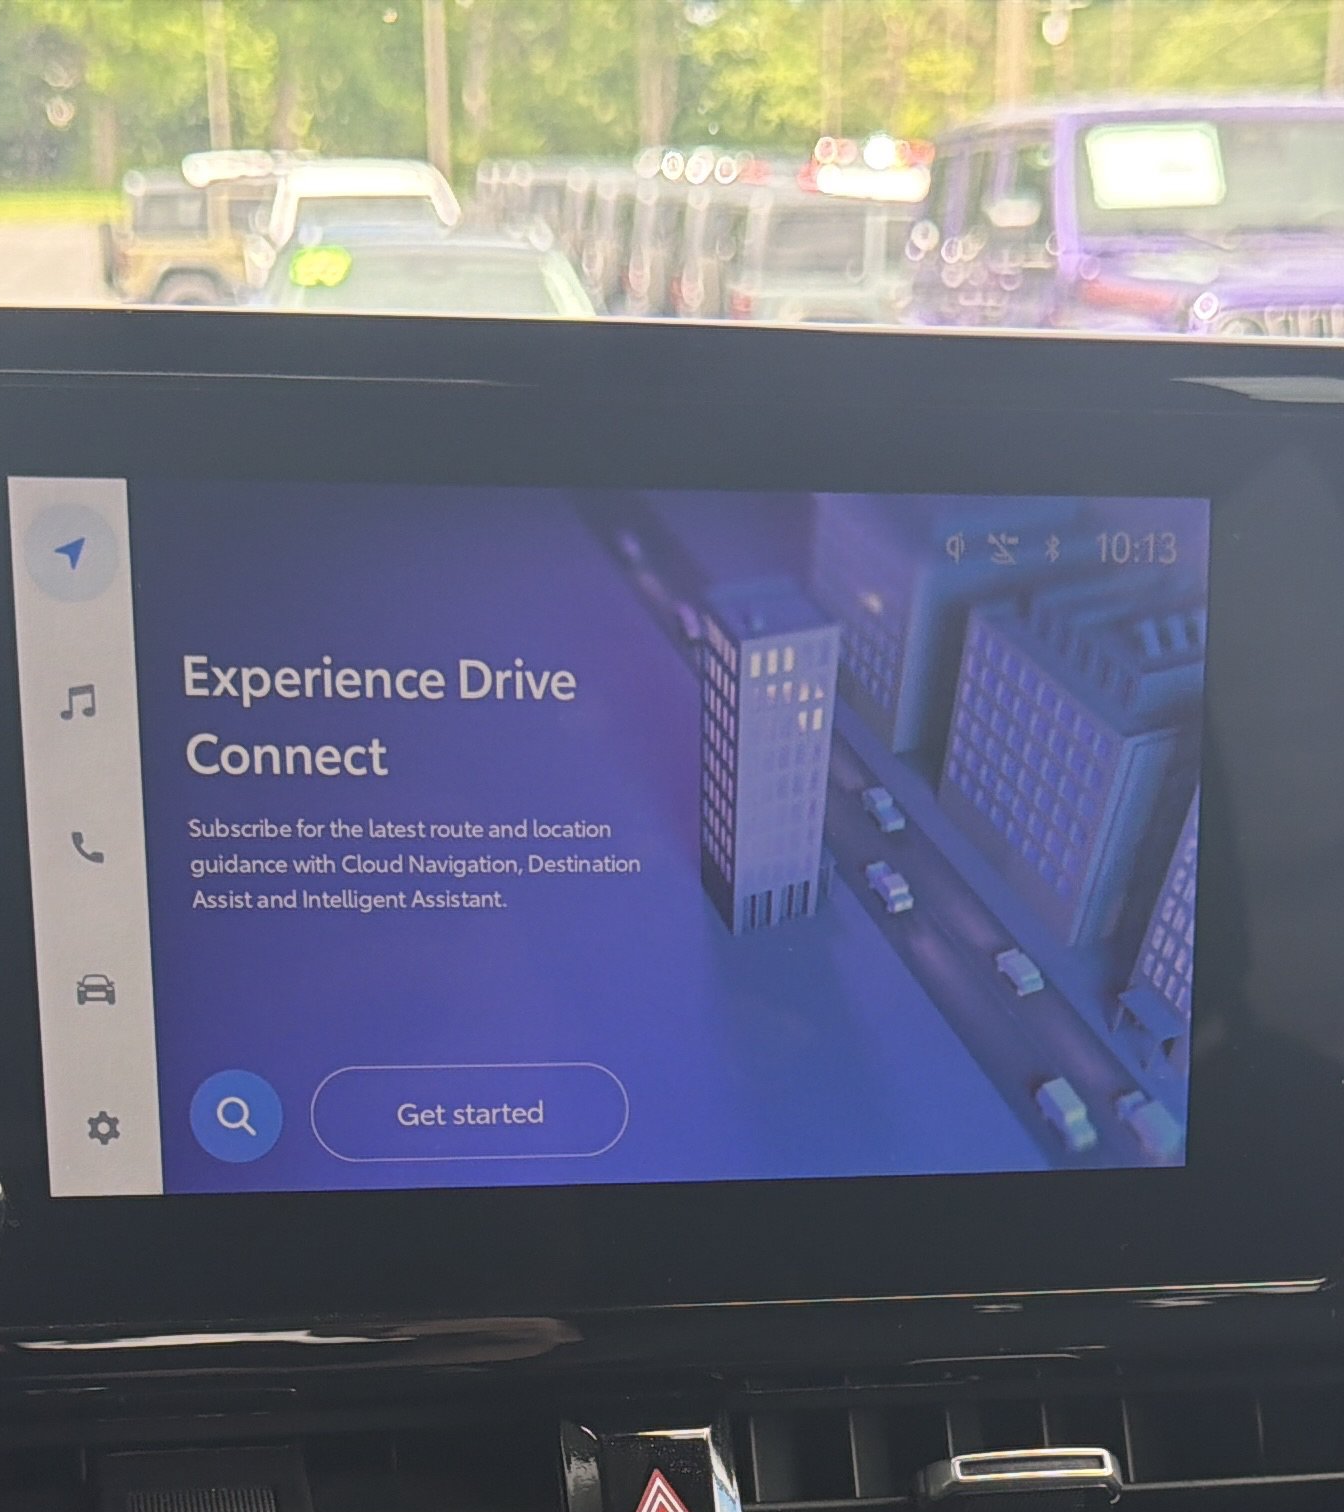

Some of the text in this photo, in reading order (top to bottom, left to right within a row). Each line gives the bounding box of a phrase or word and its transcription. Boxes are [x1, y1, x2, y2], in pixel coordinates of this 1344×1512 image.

[1096, 531, 1176, 564] 10:13
[183, 655, 577, 708] Experience Drive
[185, 732, 389, 776] Connect
[188, 817, 612, 839] Subscribe for the latest route and location
[190, 854, 641, 879] guidance with Cloud Navigation, Destination
[192, 889, 508, 914] Assist and Intelligent Assistant.
[397, 1099, 545, 1127] Get started
